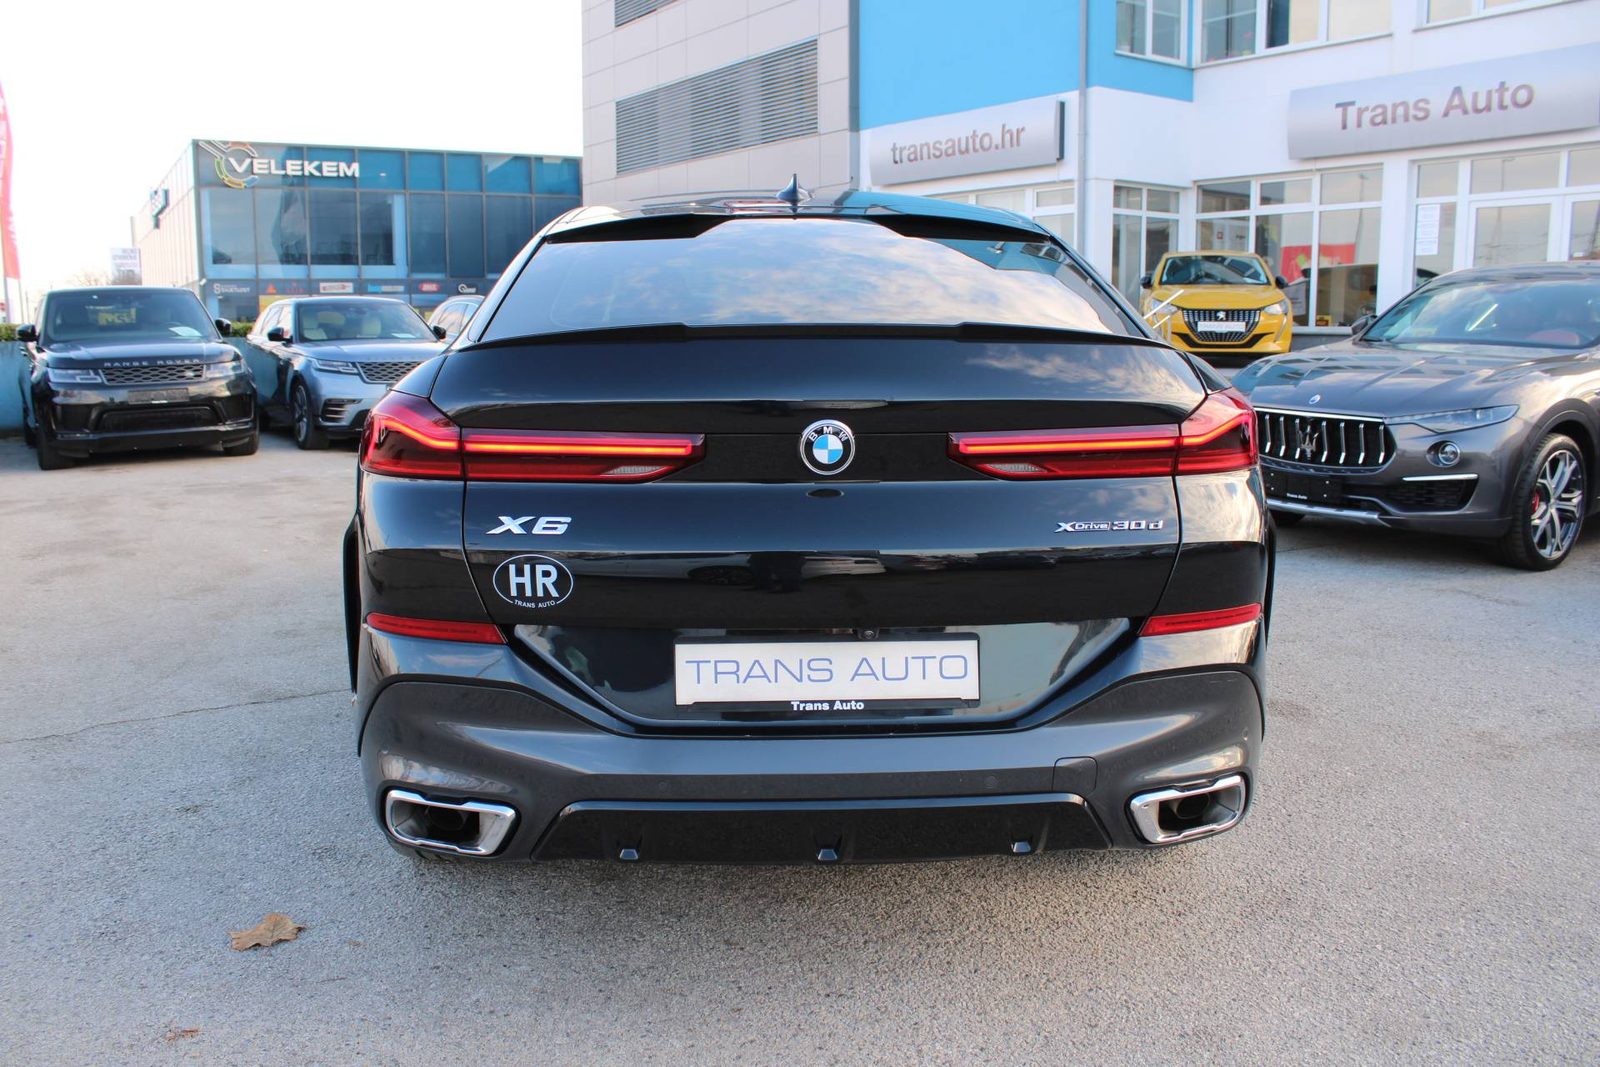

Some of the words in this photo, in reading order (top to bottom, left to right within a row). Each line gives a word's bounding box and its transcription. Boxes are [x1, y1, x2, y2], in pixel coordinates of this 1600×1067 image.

[1335, 97, 1431, 131] Trans
[1441, 80, 1535, 119] Auto
[890, 123, 1026, 165] transauto.hr
[228, 157, 360, 178] VELEKEM
[808, 426, 849, 442] BMW
[486, 516, 572, 534] X6
[508, 563, 560, 598] HR
[514, 600, 536, 609] TRANS
[537, 600, 556, 609] AUTO
[685, 657, 834, 684] TRANS
[850, 654, 968, 682] AUTO
[791, 701, 830, 711] Trans
[833, 701, 865, 711] Auto
